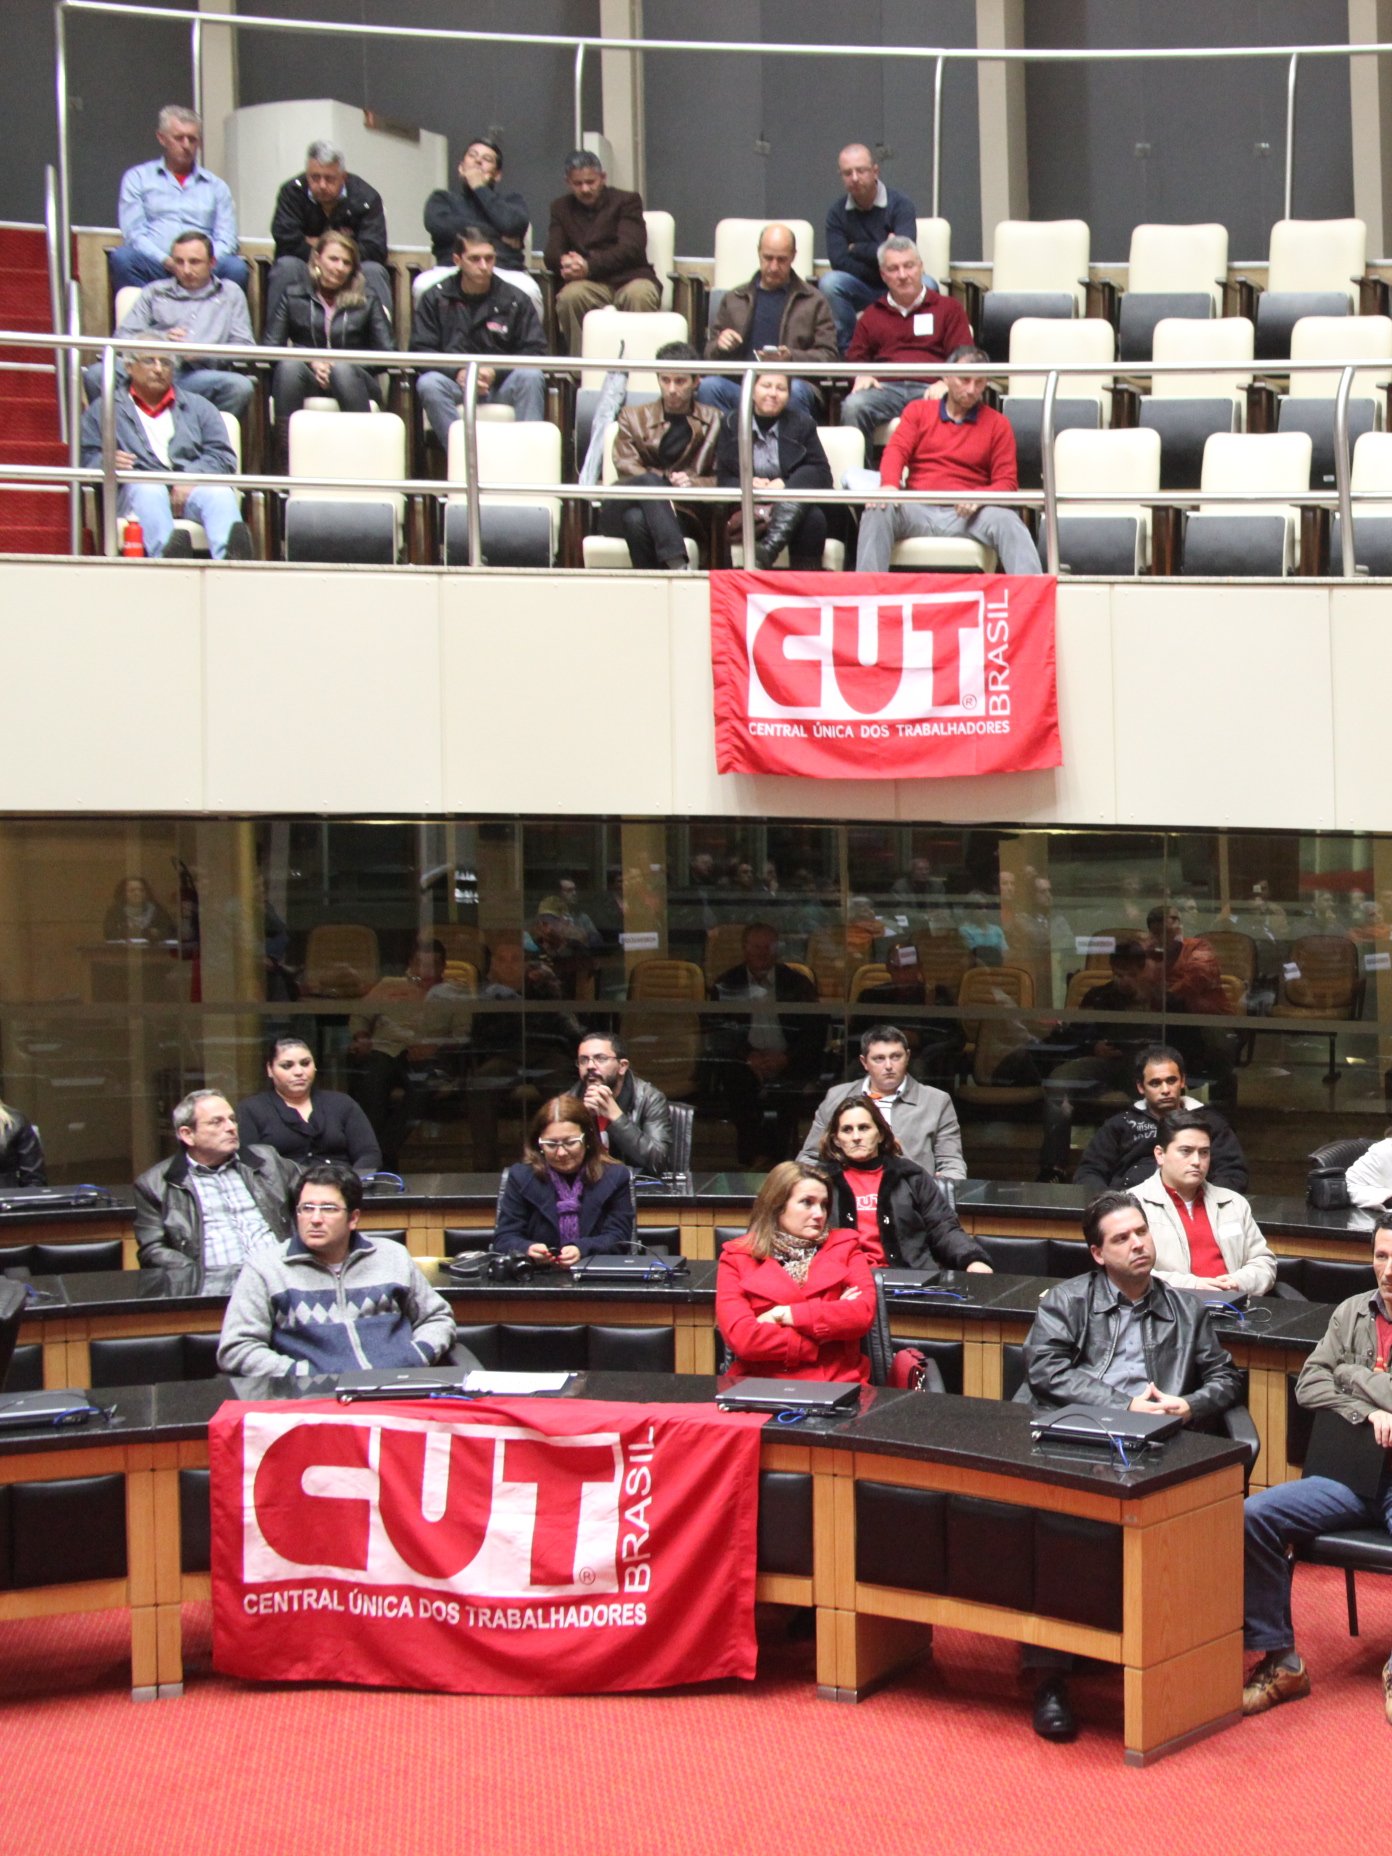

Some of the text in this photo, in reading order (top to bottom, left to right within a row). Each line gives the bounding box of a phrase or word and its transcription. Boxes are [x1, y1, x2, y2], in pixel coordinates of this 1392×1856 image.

[752, 600, 981, 715] CUT
[987, 589, 1011, 716] BRASIL
[748, 720, 1010, 738] CENTRAL ÚNICA DOS TRABALHADORES
[253, 1423, 618, 1587] CUT
[623, 1426, 654, 1594] BRASIL
[243, 1589, 648, 1630] CENTRAL ÚNICA DOS TRABALHADORES
